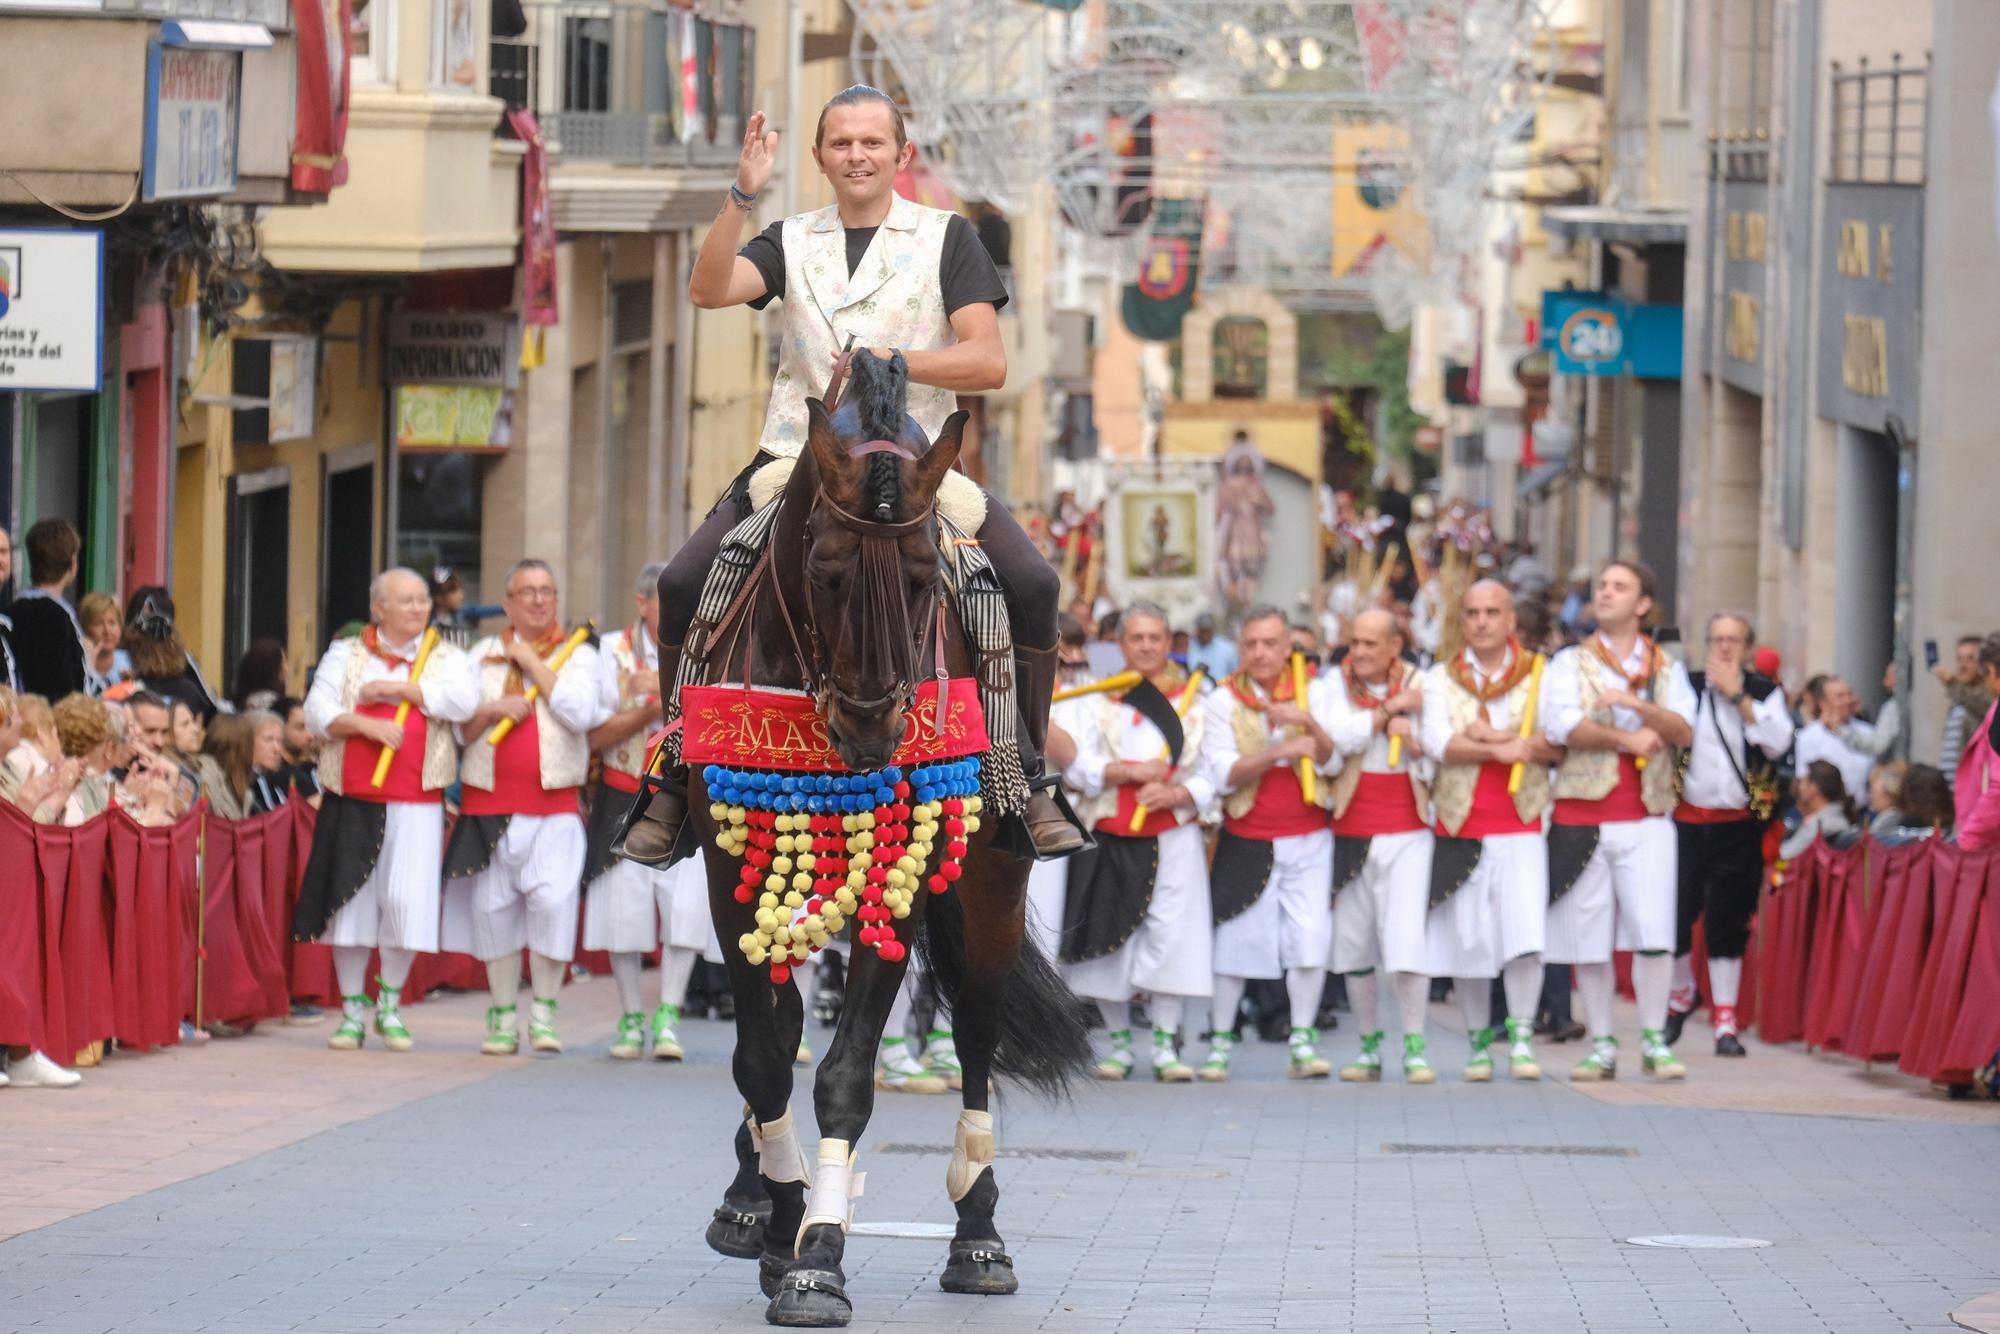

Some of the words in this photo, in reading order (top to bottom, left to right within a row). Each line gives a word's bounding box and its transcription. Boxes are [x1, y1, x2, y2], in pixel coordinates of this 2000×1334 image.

[30, 330, 38, 343] y
[411, 320, 486, 338] DIARIO
[39, 344, 61, 359] del
[393, 346, 501, 377] INFORMACION
